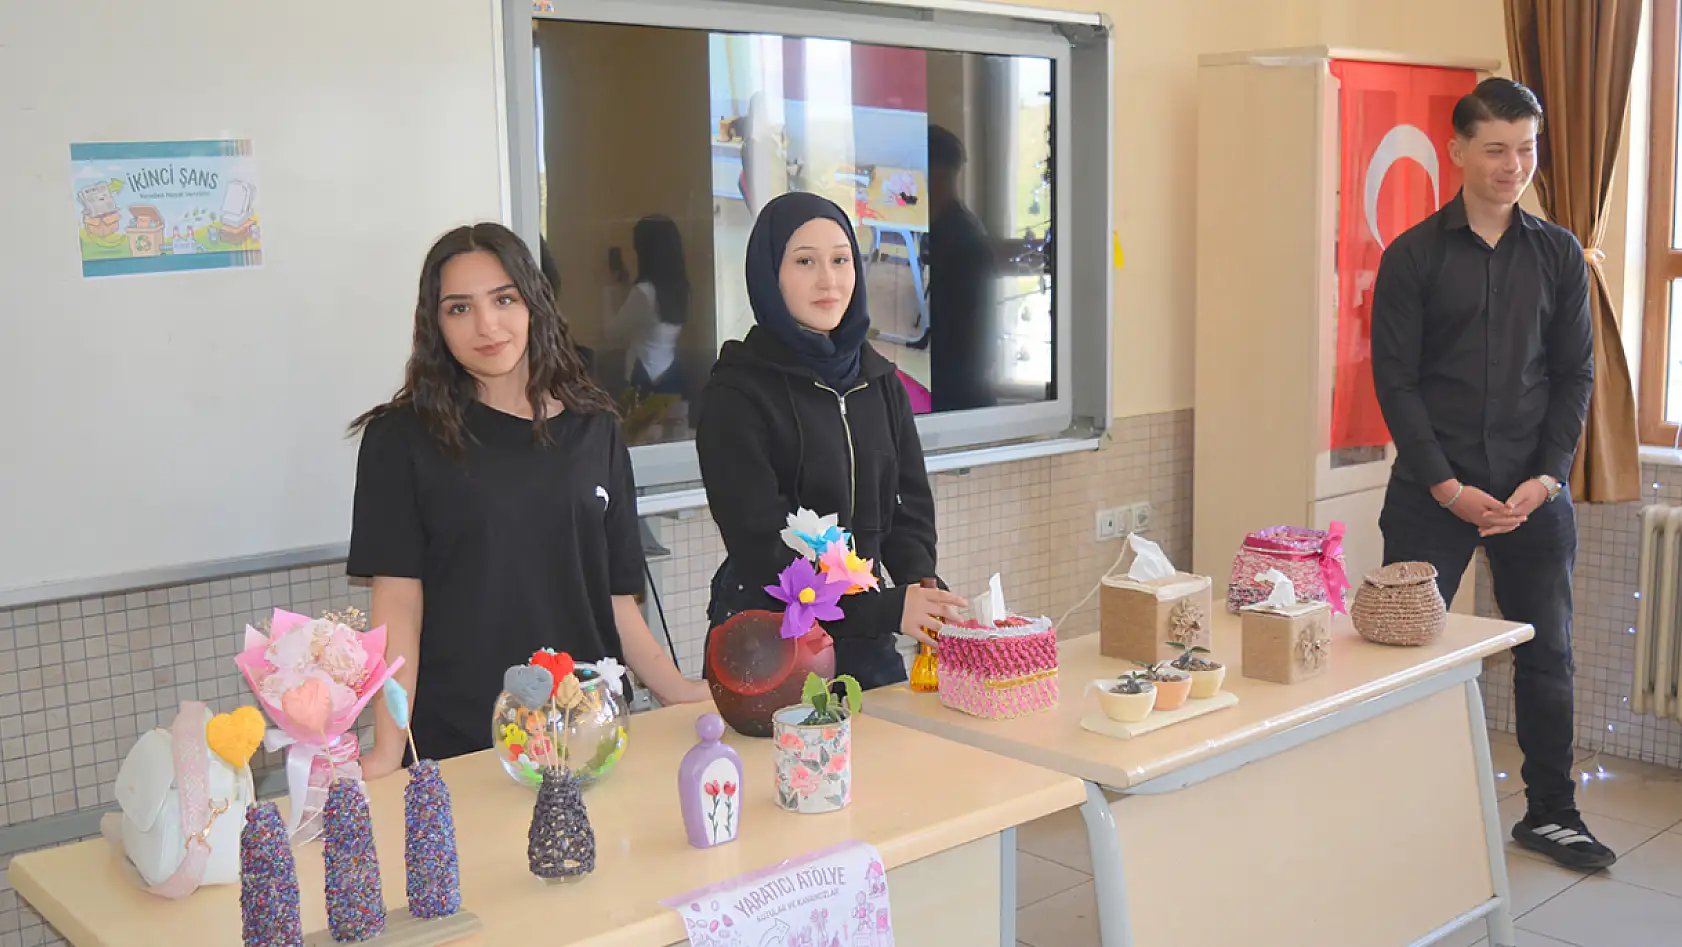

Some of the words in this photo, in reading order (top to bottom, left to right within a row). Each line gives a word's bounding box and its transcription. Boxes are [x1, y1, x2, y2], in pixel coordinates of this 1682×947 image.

[126, 163, 174, 192] İKİNCİ
[179, 167, 218, 189] ŞANS
[734, 877, 796, 918] YARATICI
[797, 866, 846, 889] ATÖLYE
